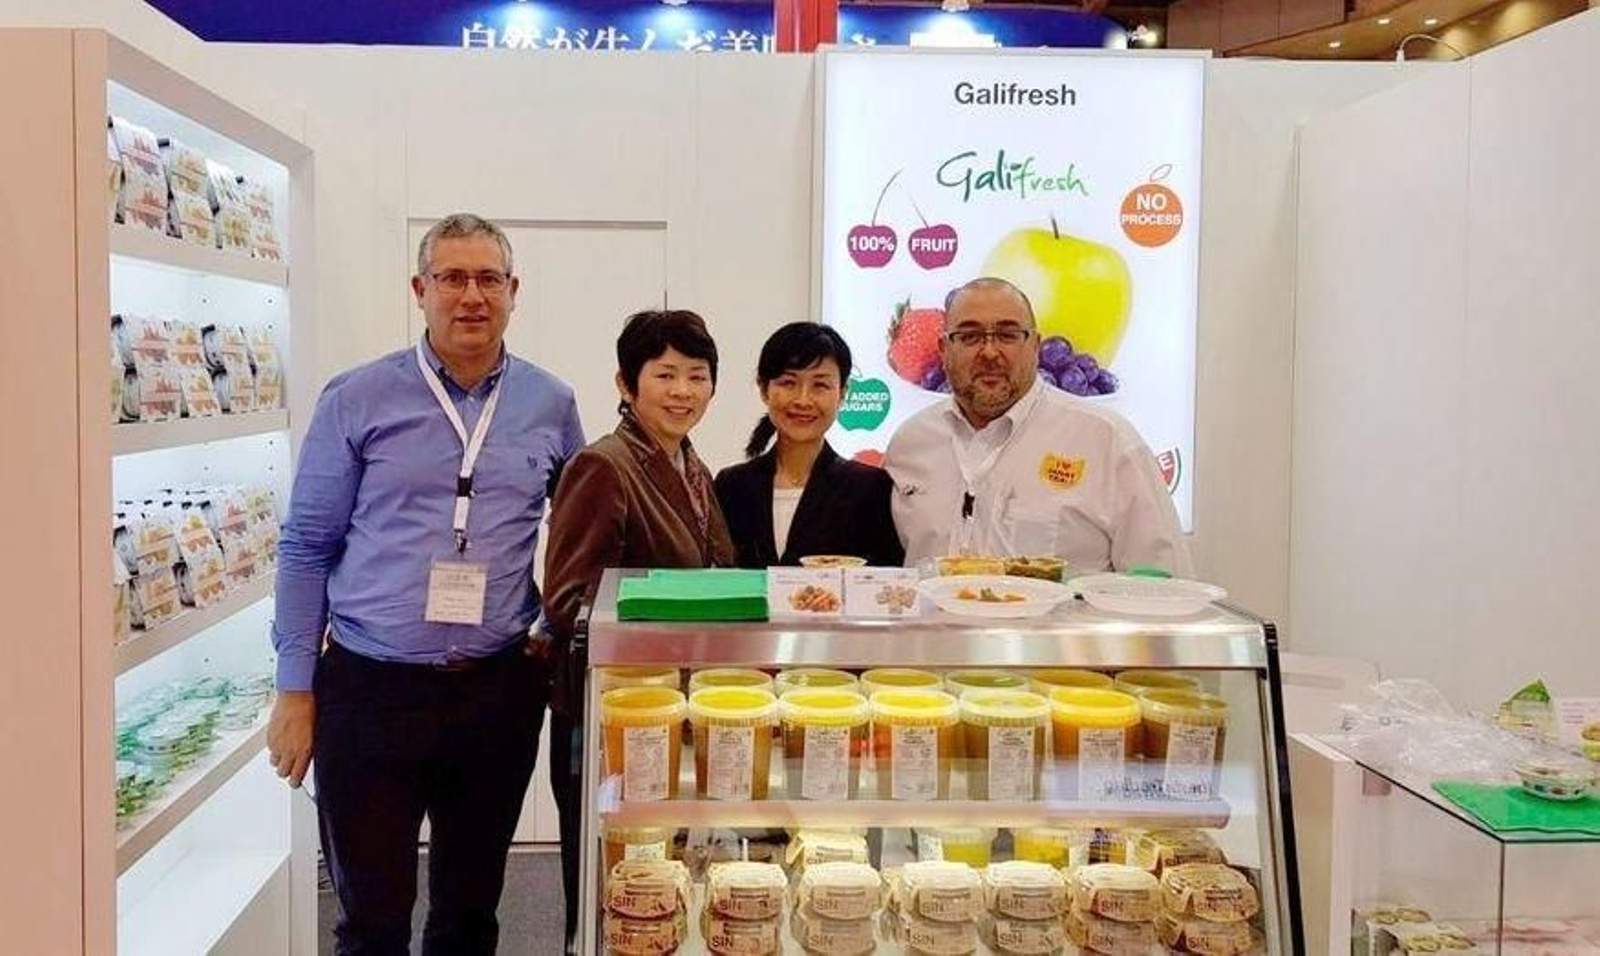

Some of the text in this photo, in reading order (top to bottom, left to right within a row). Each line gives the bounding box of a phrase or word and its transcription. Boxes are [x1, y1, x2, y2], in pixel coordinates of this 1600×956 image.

[954, 81, 1077, 107] Galifresh
[936, 149, 1089, 202] Galifresh
[1136, 192, 1168, 211] NO
[1121, 213, 1182, 226] PROCESS
[850, 235, 956, 254] 100% FRUIT
[850, 391, 889, 402] ADDED
[613, 896, 636, 908] SIN
[610, 933, 632, 946] SIN
[711, 936, 733, 948] SIN
